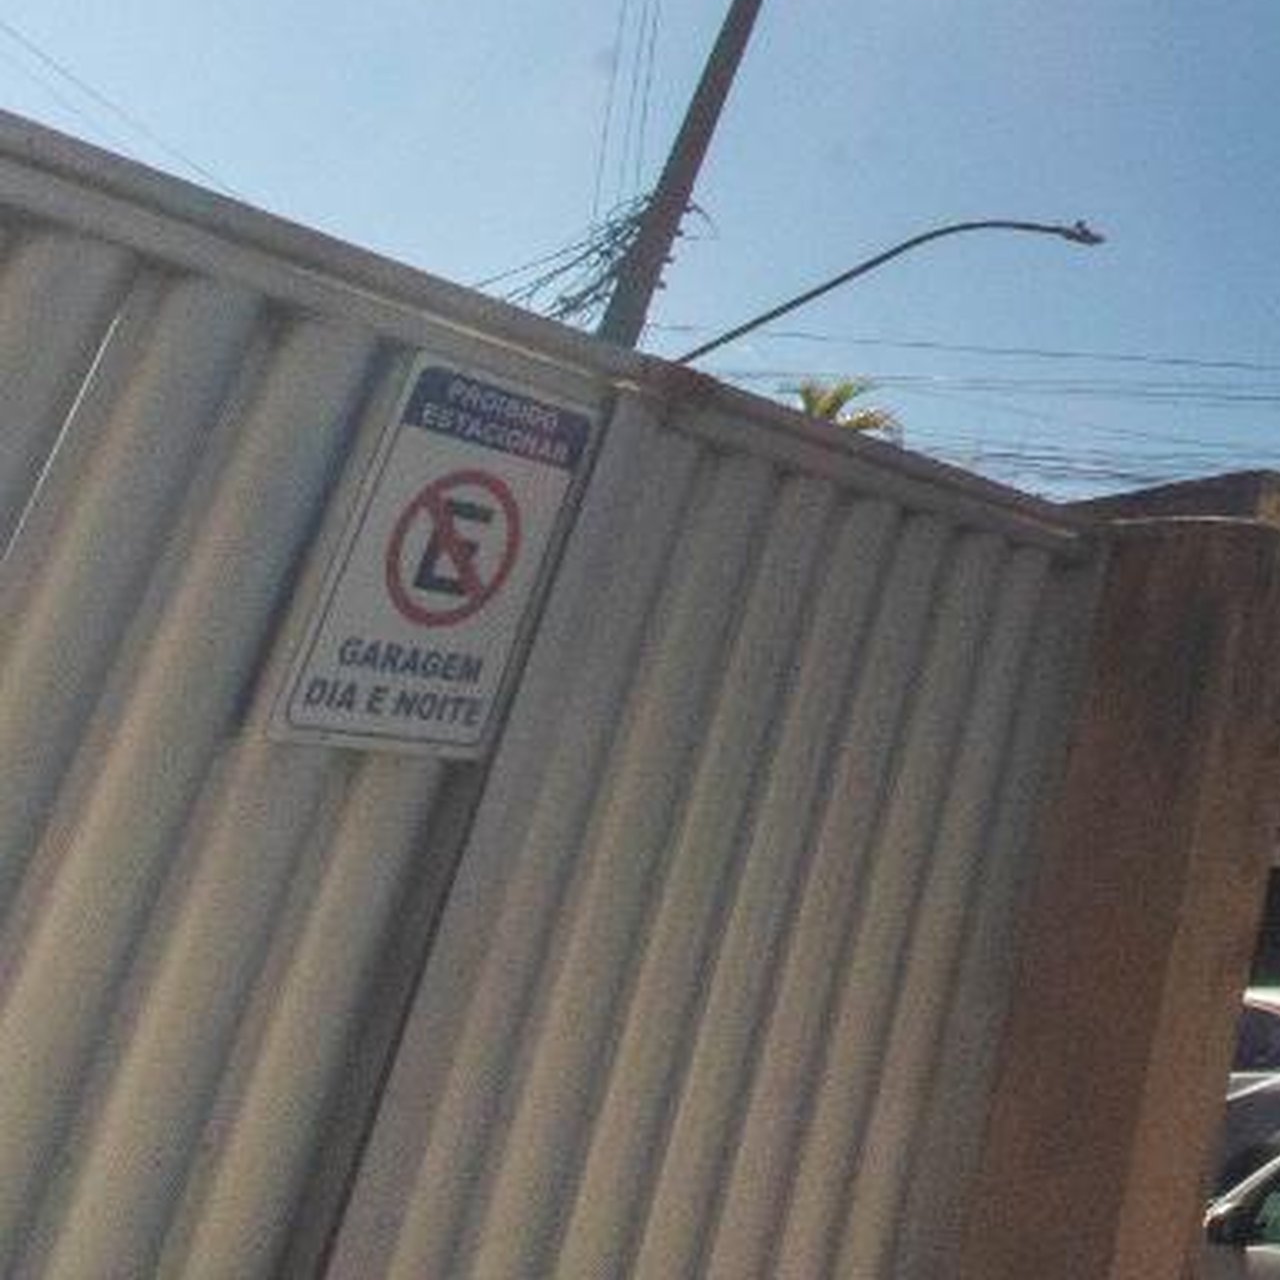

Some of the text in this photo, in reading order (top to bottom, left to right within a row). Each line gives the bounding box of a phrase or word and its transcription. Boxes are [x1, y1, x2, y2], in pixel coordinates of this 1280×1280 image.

[421, 401, 569, 463] ESTACIONAR
[338, 636, 484, 683] GARAGEM
[303, 677, 484, 726] DIA E NOITE
